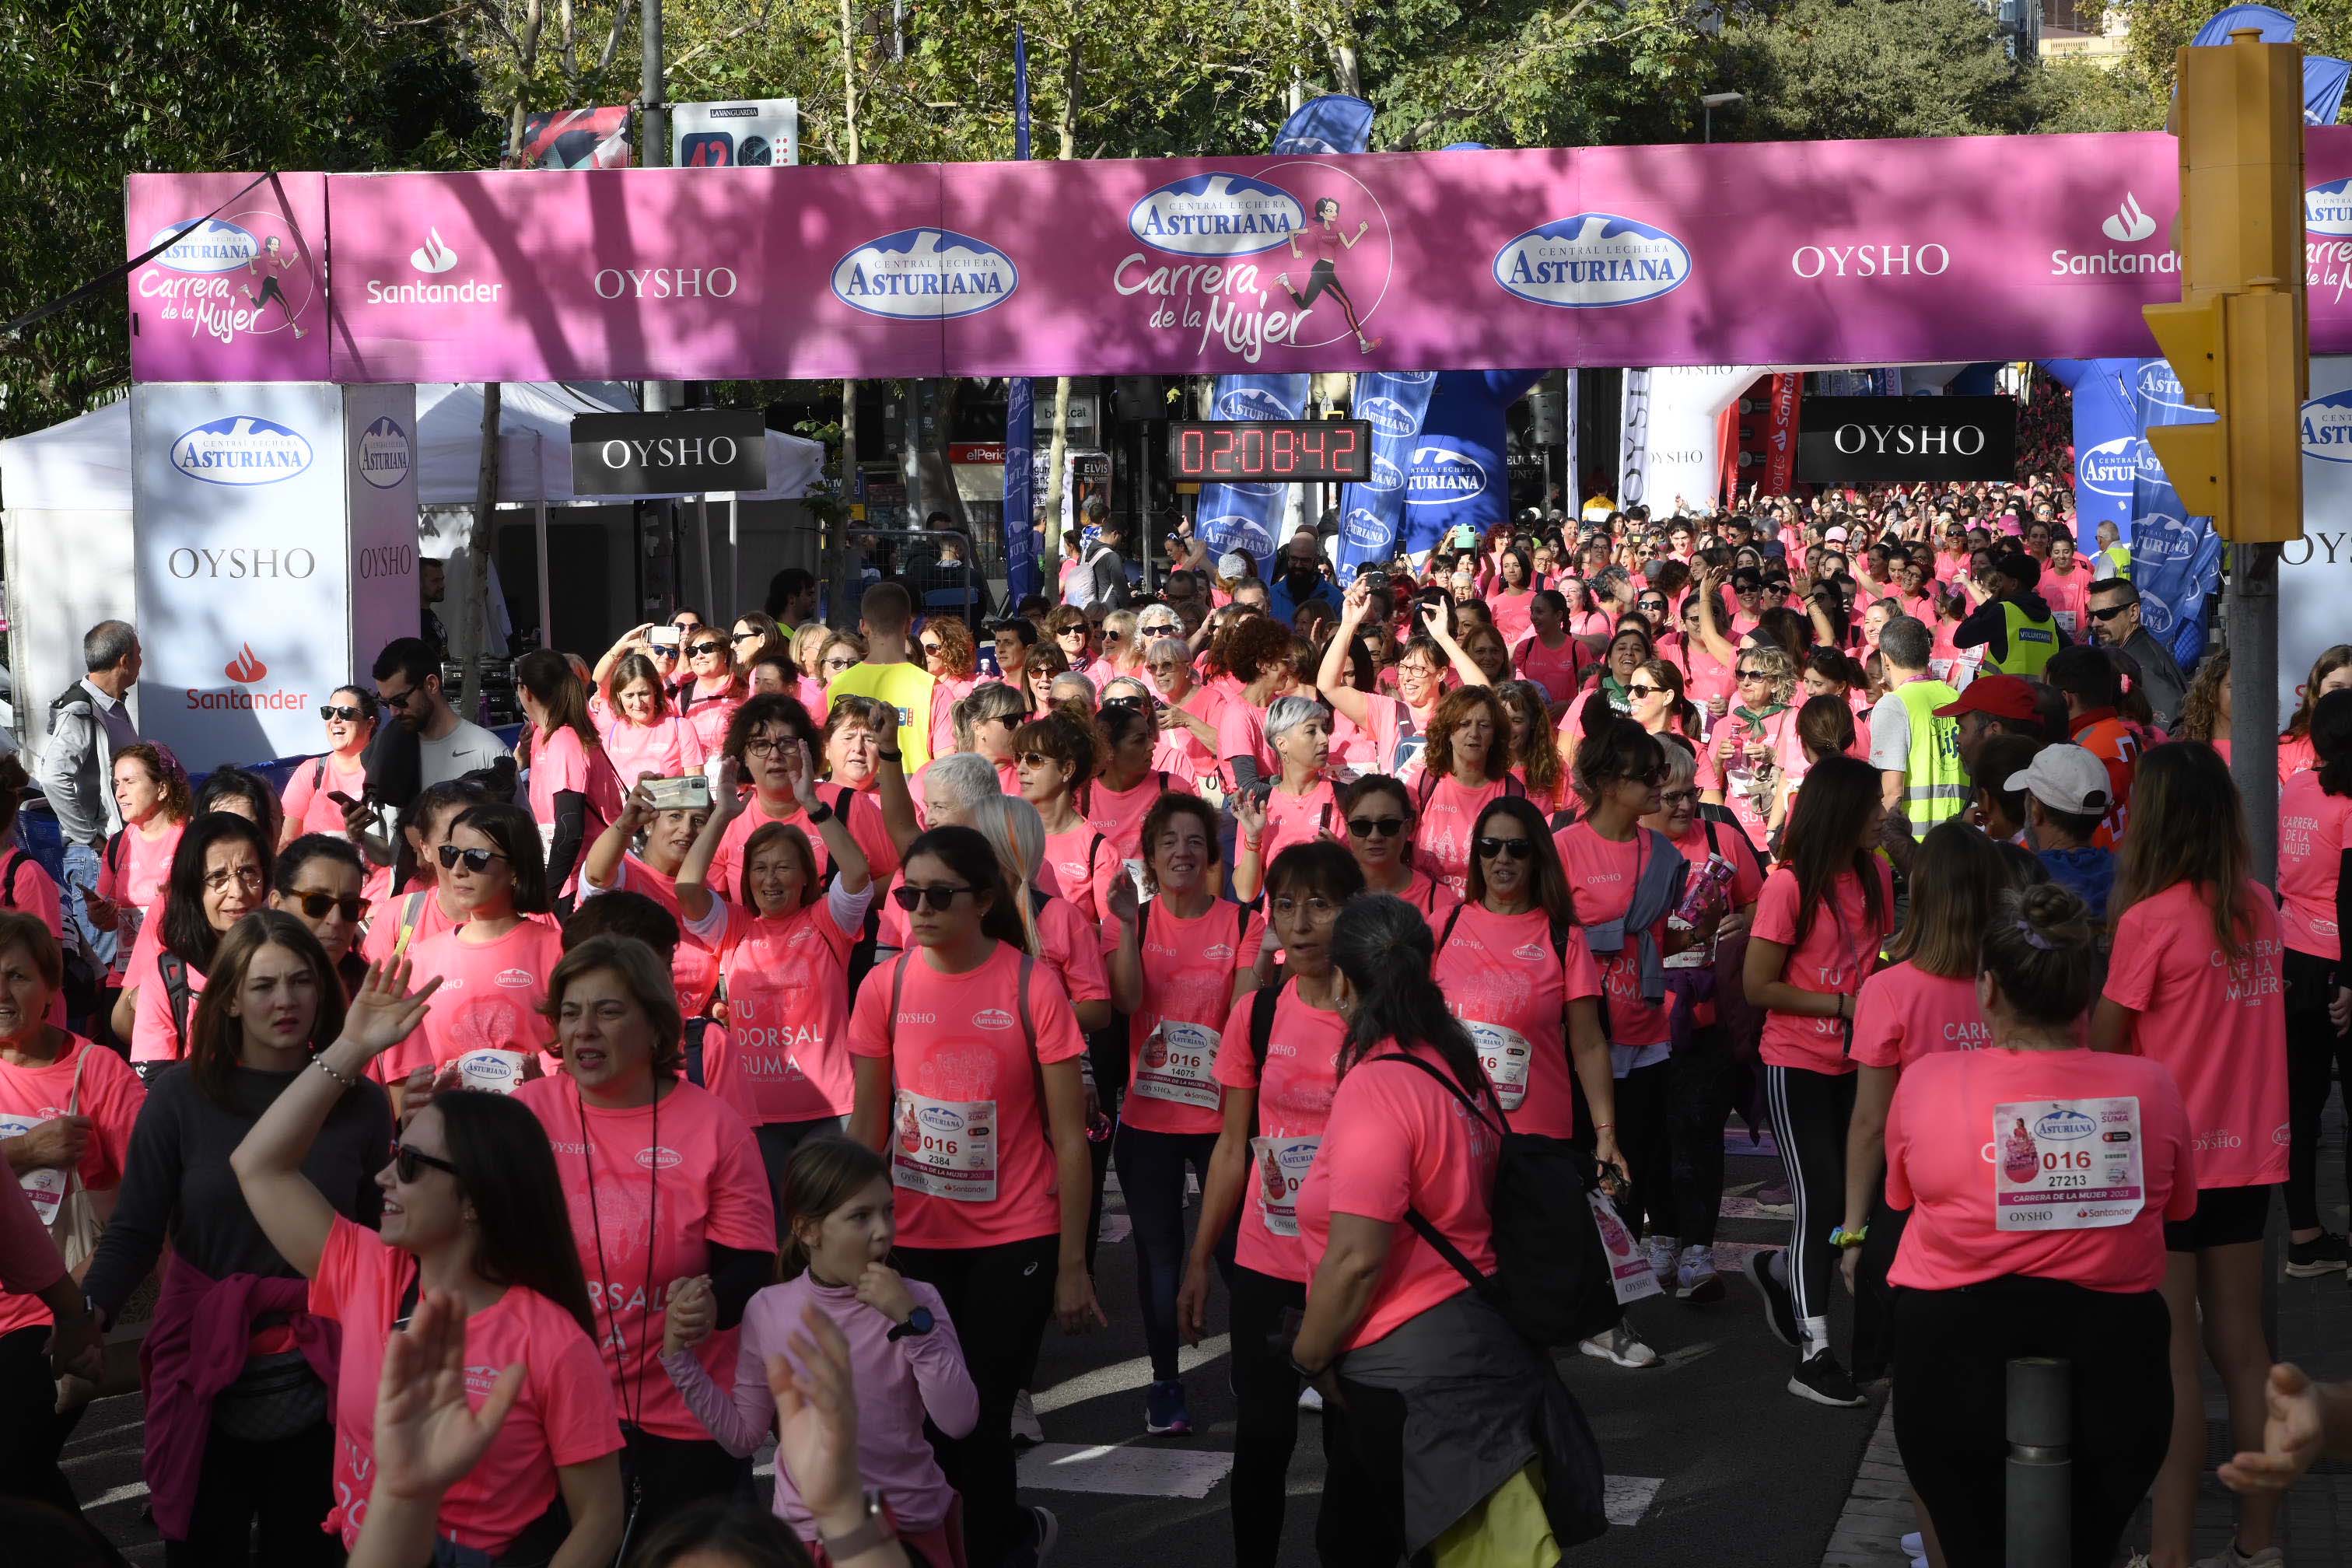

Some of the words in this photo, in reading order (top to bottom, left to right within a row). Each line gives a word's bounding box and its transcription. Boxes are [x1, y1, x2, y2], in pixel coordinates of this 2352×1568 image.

[1169, 201, 1223, 211] CENTRAL
[1230, 200, 1286, 209] LECHERA
[1142, 205, 1292, 236] ASTURIANA
[1539, 247, 1600, 256] CENTRAL
[1606, 245, 1668, 254] LECHERA
[874, 260, 935, 268] CENTRAL
[939, 258, 996, 268] LECHERA
[1508, 250, 1675, 284] ASTURIANA
[1792, 243, 1950, 278] OYSHO
[138, 269, 229, 299] Carrera
[594, 267, 737, 299] OYSHO
[845, 262, 1003, 296] ASTURIANA
[1113, 253, 1258, 296] Carrera
[367, 279, 502, 304] Santander
[161, 300, 178, 320] de
[181, 298, 194, 320] la
[192, 296, 264, 343] Mujer
[1150, 298, 1176, 328] de
[1182, 296, 1202, 328] la
[1198, 290, 1314, 363] Mujer
[1362, 405, 1409, 434] ASTURIANA
[1834, 424, 1985, 455] OYSHO
[181, 442, 303, 467] ASTURIANA
[362, 443, 408, 471] ASTURIANA
[601, 436, 737, 468] OYSHO
[1180, 430, 1356, 472] 02:08:42
[1083, 463, 1108, 474] ELVIS
[1409, 475, 1479, 490] TURIANA
[1204, 526, 1269, 555] ASTURIANA
[169, 548, 315, 579] OYSHO
[360, 544, 411, 579] OYSHO
[187, 688, 307, 710] Santander
[2282, 816, 2319, 831] CARRERA
[2285, 829, 2297, 841] DE
[2298, 831, 2309, 843] LA
[2283, 842, 2311, 856] MUJER
[1587, 873, 1622, 884] OYSHO
[1818, 968, 1842, 986] TU
[2256, 959, 2274, 977] LA
[2225, 976, 2280, 1002] MUJER
[733, 999, 754, 1020] TU
[738, 1024, 823, 1047] DORSAL
[1171, 1034, 1206, 1046] ASTURIANA
[467, 1063, 508, 1076] ASTURIANA
[1170, 1052, 1201, 1068] 016
[1479, 1056, 1497, 1069] 16
[1146, 1074, 1171, 1083] CARRERA
[1171, 1068, 1195, 1078] 14075
[923, 1113, 961, 1128] ASTURIANA
[2039, 1122, 2092, 1135] ASTURIANA
[924, 1136, 958, 1154] 016
[904, 1160, 928, 1171] CARRERA
[929, 1154, 950, 1166] 2384
[2042, 1150, 2091, 1171] 016
[2049, 1175, 2087, 1187] 27213
[2013, 1194, 2051, 1202] CARRERA
[2010, 1211, 2053, 1223] OYSHO
[2089, 1207, 2133, 1218] Santander
[587, 1281, 665, 1312] RSAL
